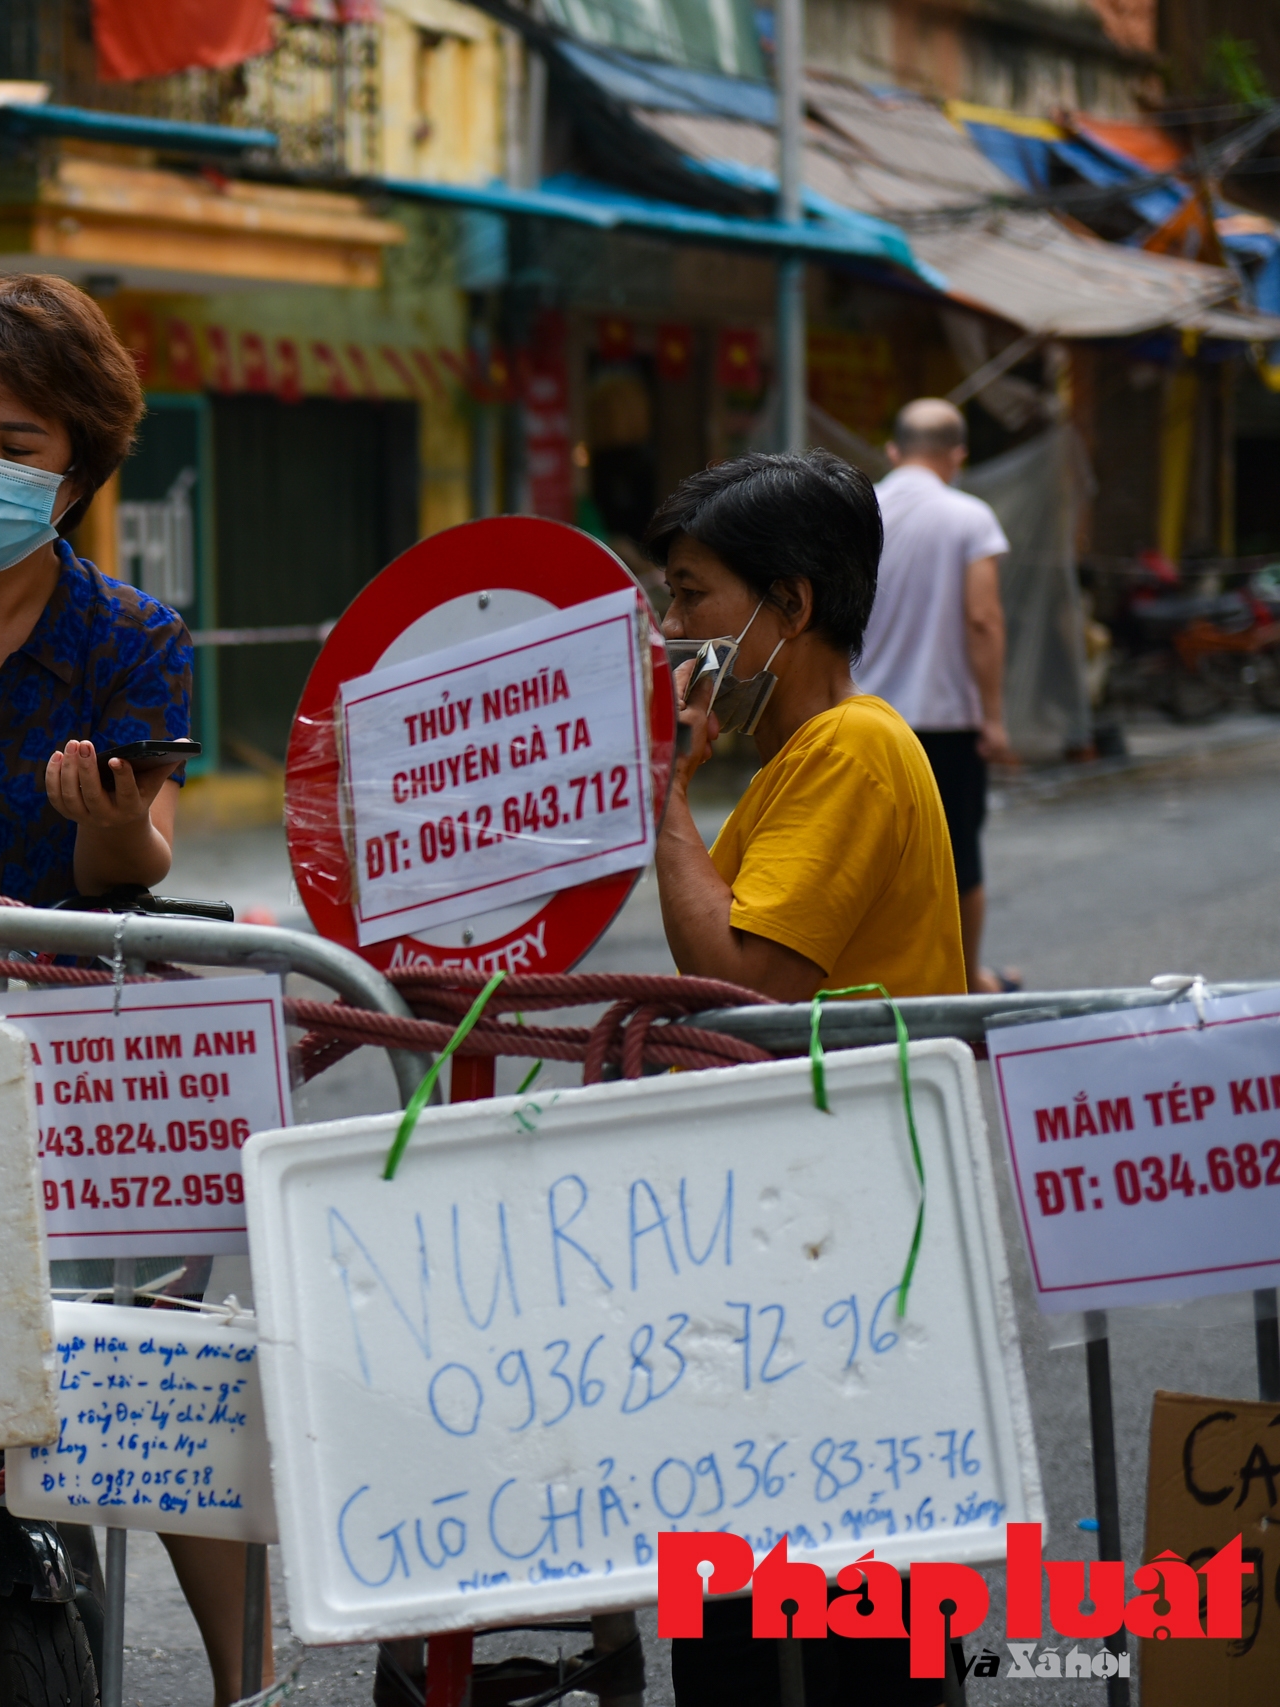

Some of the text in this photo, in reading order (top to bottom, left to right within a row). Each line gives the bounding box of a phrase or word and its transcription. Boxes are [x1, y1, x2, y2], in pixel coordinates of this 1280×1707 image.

[404, 666, 570, 747] THỦY NGHĨA
[391, 717, 591, 804] CHUYÊN GÀ TA
[365, 765, 630, 880] ĐT: 0912.643.712
[50, 1037, 114, 1065] TƯƠI
[125, 1034, 183, 1061] KIM
[193, 1030, 257, 1058] ANH
[54, 1071, 114, 1105] CẦN
[122, 1070, 169, 1101] THÌ
[180, 1072, 230, 1103] GỌI
[1034, 1090, 1134, 1143] MẮM
[1144, 1081, 1216, 1128] TÉP
[1034, 1166, 1104, 1216] ĐT:
